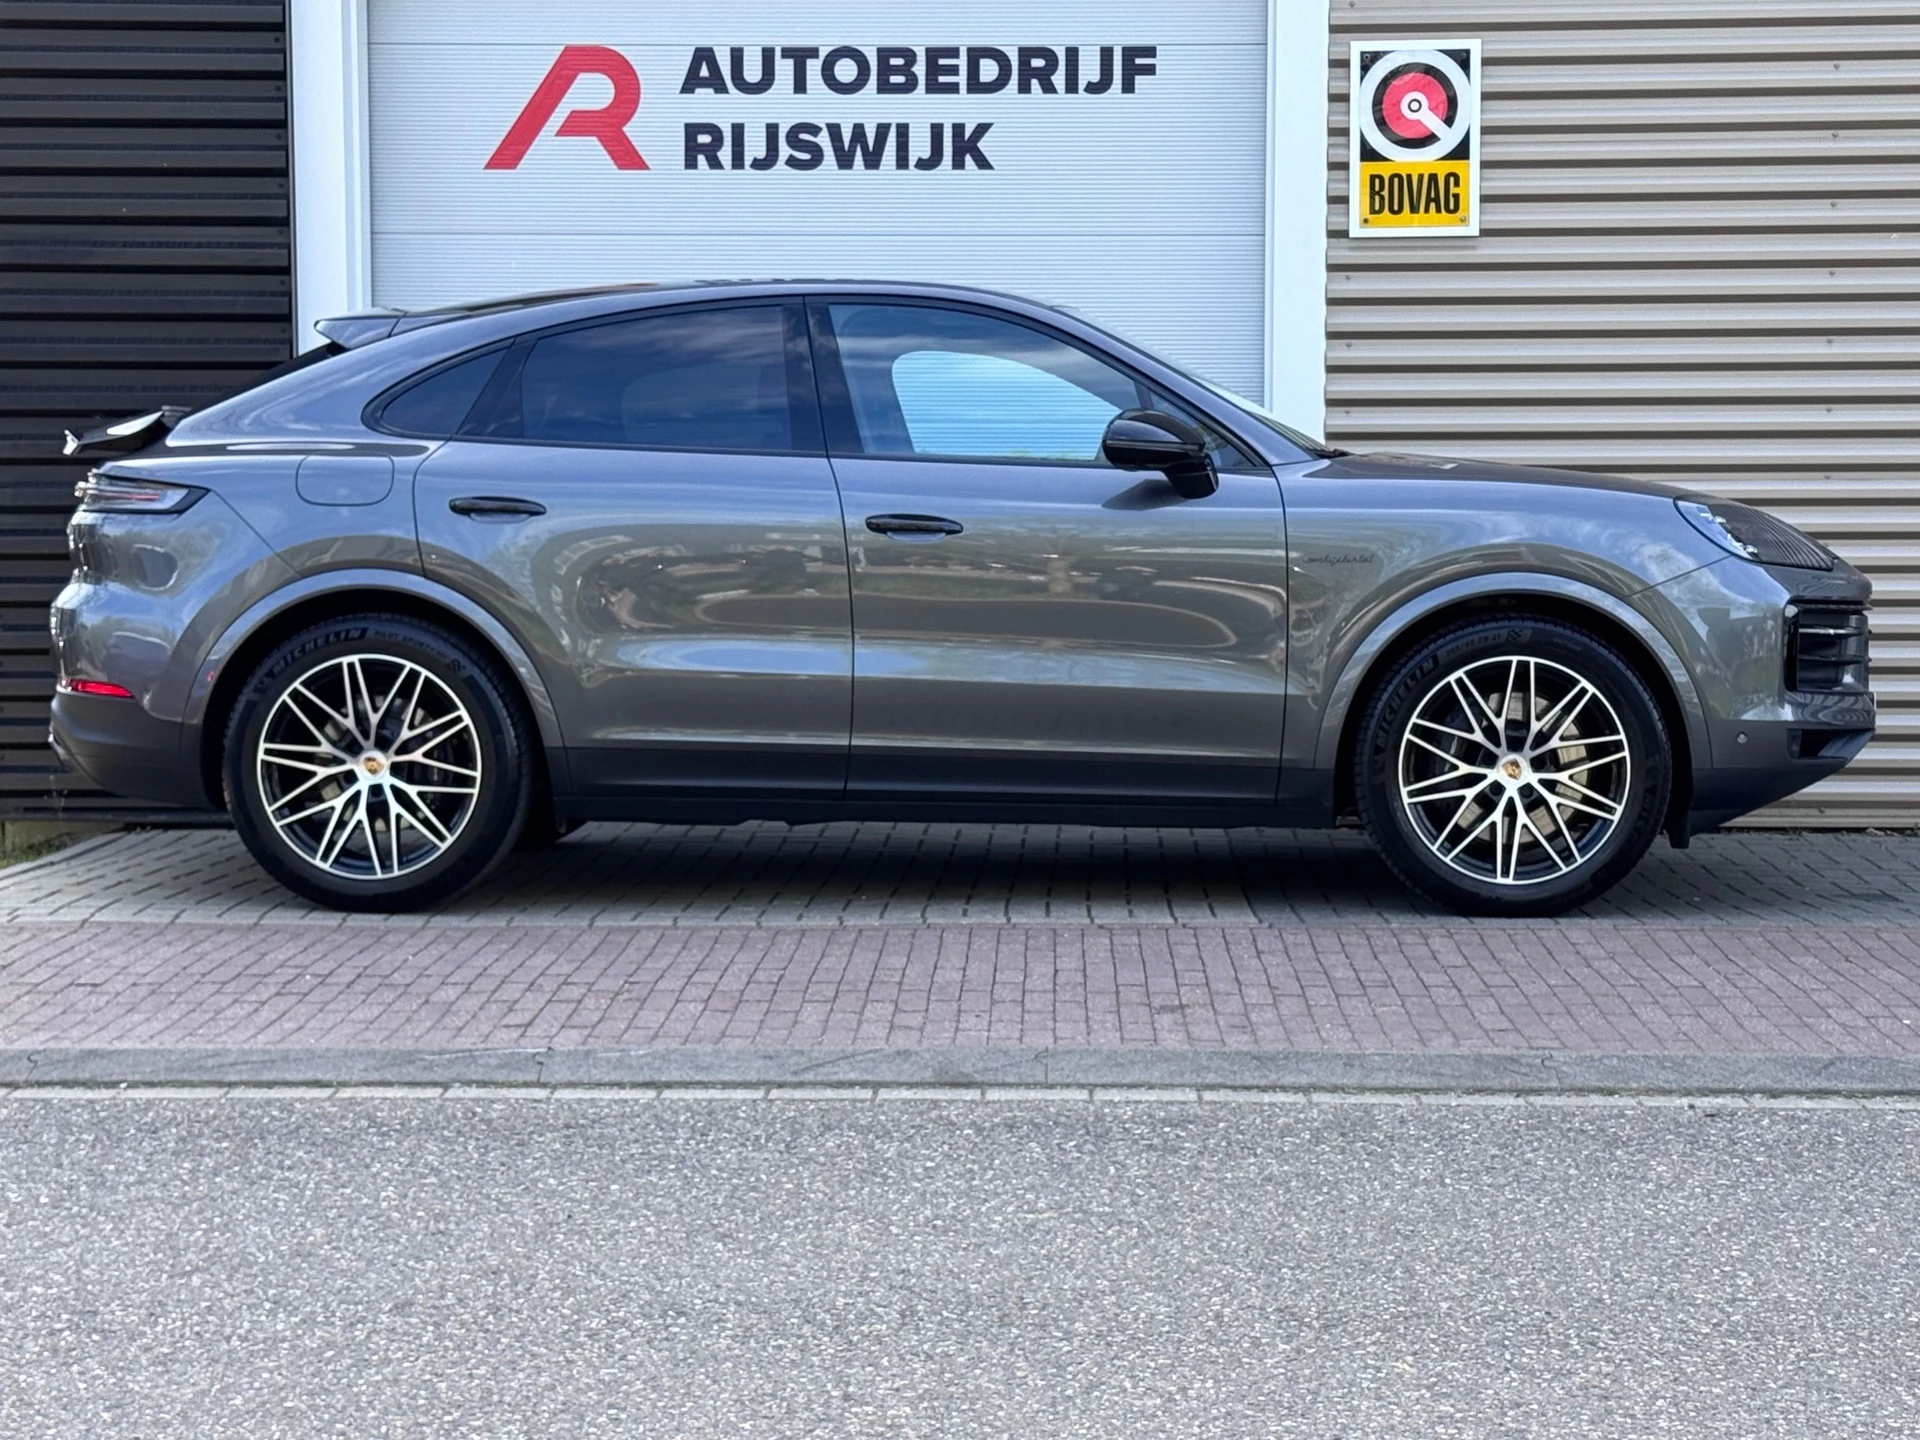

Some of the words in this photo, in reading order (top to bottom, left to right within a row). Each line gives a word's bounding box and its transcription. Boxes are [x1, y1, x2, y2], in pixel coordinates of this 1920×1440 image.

[680, 45, 1157, 94] AUTOBEDRIJF
[684, 122, 994, 170] RIJSWIJK
[1369, 172, 1461, 215] BOVAG
[272, 628, 364, 676] MICHELIN
[1375, 655, 1435, 748] MICHELIN
